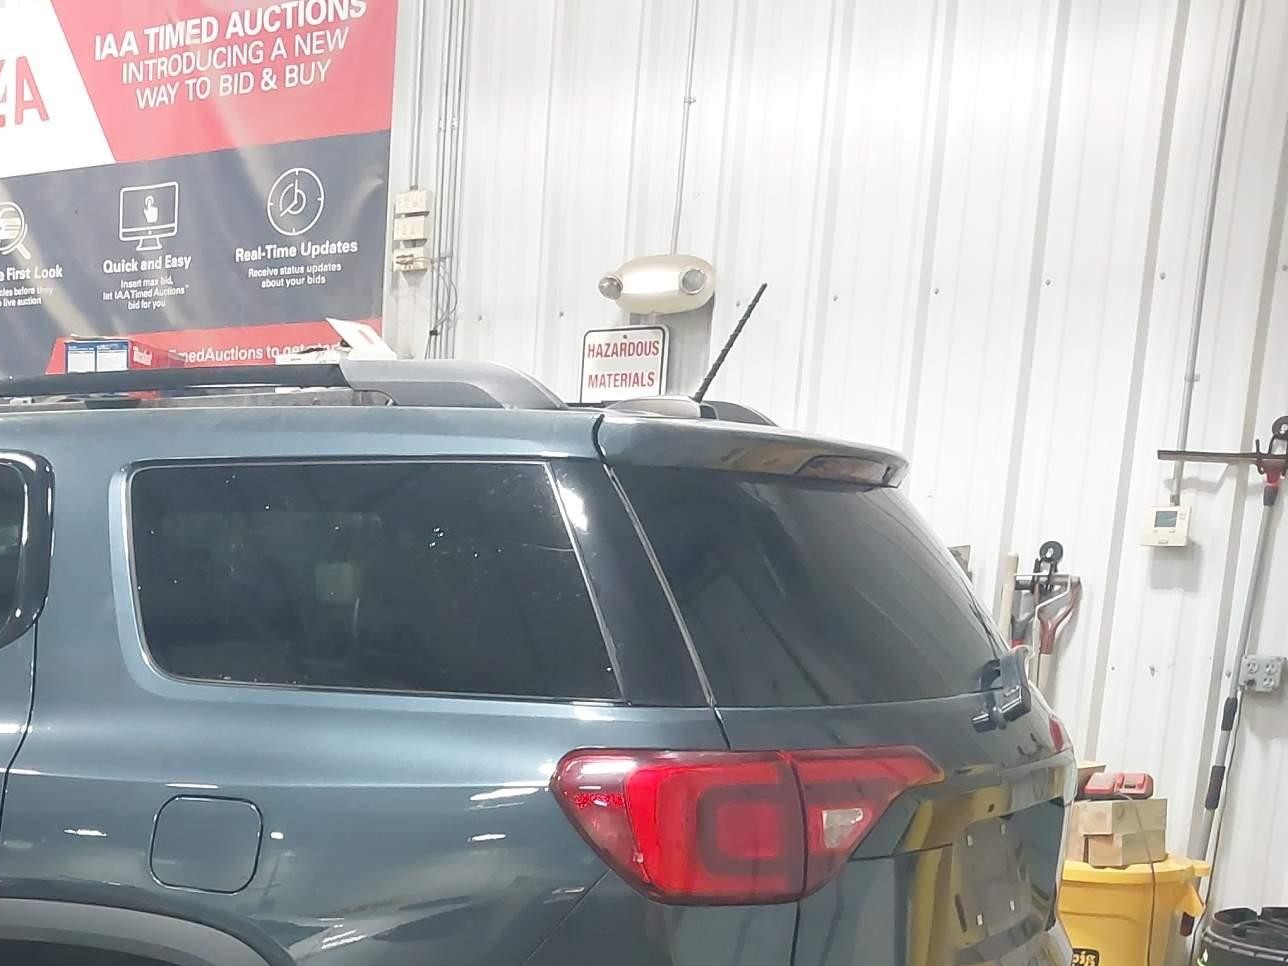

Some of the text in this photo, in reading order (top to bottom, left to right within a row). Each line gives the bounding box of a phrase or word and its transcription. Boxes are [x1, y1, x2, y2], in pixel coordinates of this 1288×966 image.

[94, 0, 367, 61] IAA TIMED AUCTIONS
[121, 26, 350, 84] INTRODUCING A NEW
[135, 58, 331, 110] WAY TO BID & BUY
[235, 240, 358, 262] Real-Time Updates
[103, 254, 192, 274] Quick and Easy
[248, 263, 342, 278] Receive status updates
[6, 266, 31, 281] First
[34, 264, 63, 279] Look
[120, 279, 142, 289] Insert
[143, 278, 159, 287] max
[261, 275, 326, 288] about your bids
[14, 286, 35, 296] before
[114, 290, 130, 300] IAA
[130, 289, 153, 299] Timed
[3, 298, 16, 307] live
[17, 297, 42, 306] auction
[127, 299, 166, 310] bid for you
[266, 345, 279, 359] to
[587, 340, 660, 358] HAZARDOUS
[587, 371, 655, 388] MATERIALS
